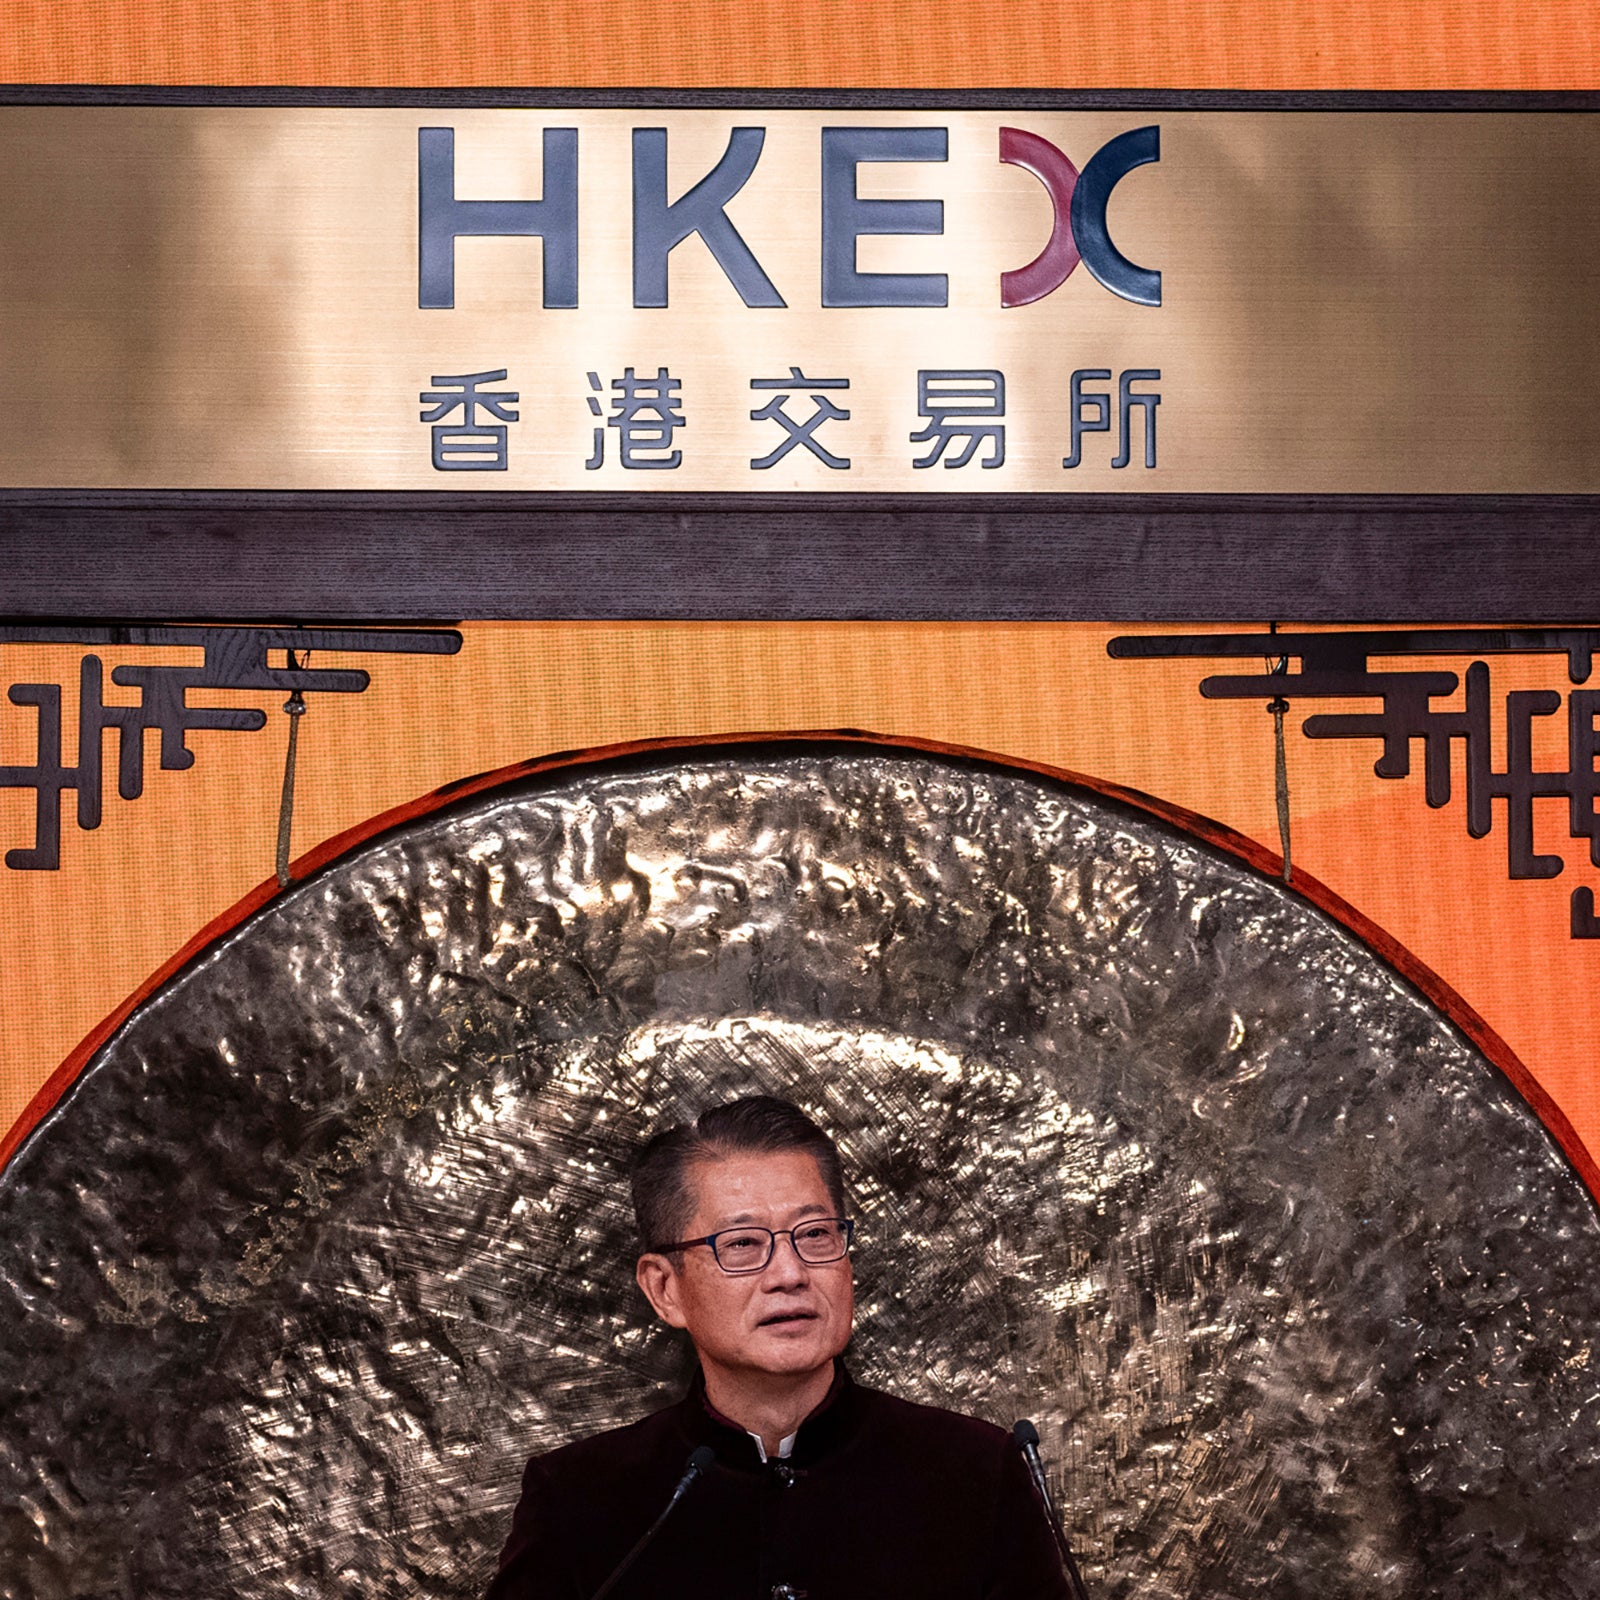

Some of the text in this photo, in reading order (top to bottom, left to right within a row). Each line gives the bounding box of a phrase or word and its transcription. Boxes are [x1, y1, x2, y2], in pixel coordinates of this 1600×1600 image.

[418, 125, 1162, 309] HKEX
[418, 367, 1162, 471] 香港交易所
